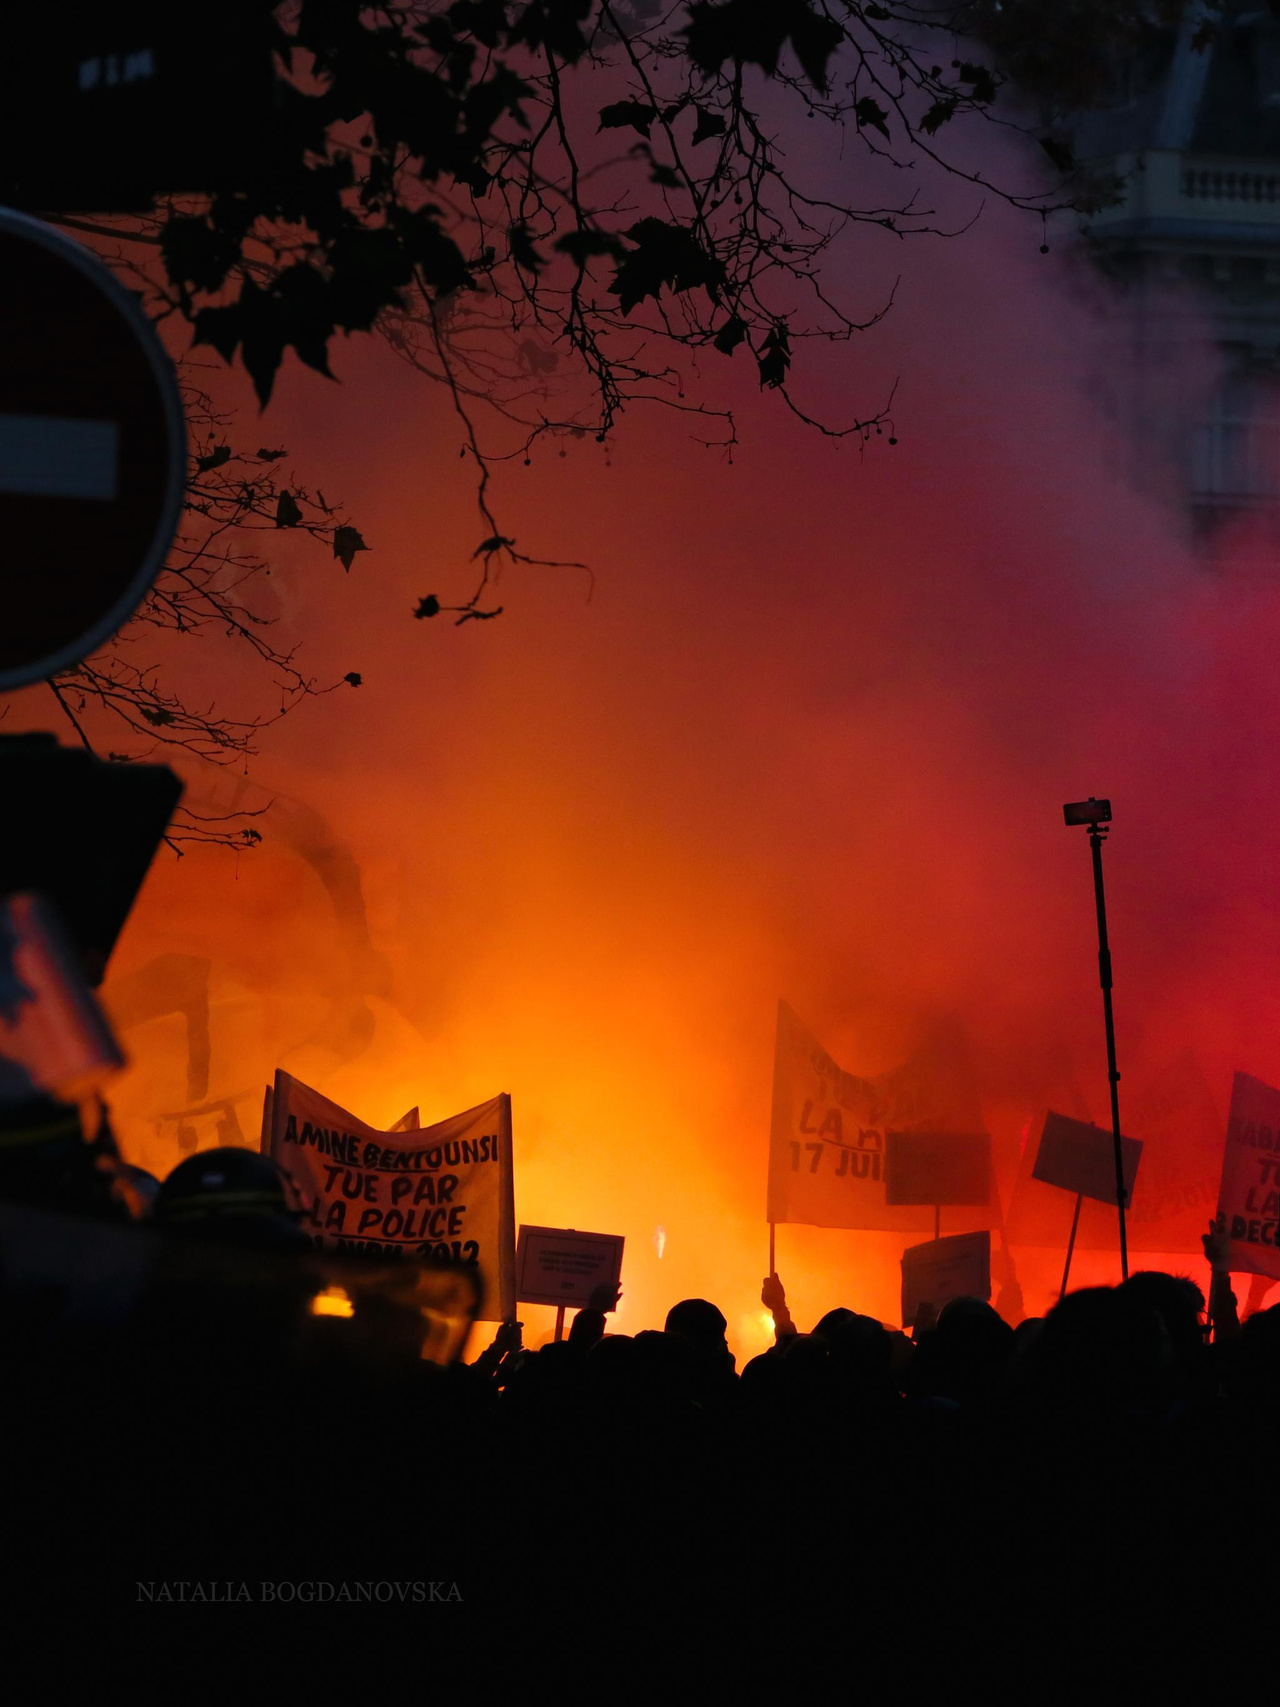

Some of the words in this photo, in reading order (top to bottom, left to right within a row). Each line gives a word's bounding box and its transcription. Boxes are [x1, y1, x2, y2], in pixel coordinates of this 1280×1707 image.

[283, 1115, 361, 1163] AMINE
[363, 1134, 499, 1170] BENTOUNSI
[789, 1141, 823, 1174] 17
[835, 1150, 885, 1181] JUI
[323, 1164, 379, 1202] TUE
[391, 1174, 459, 1206] PAR
[1245, 1187, 1279, 1216] LA
[311, 1196, 346, 1232] LA
[357, 1206, 466, 1238] POLICE
